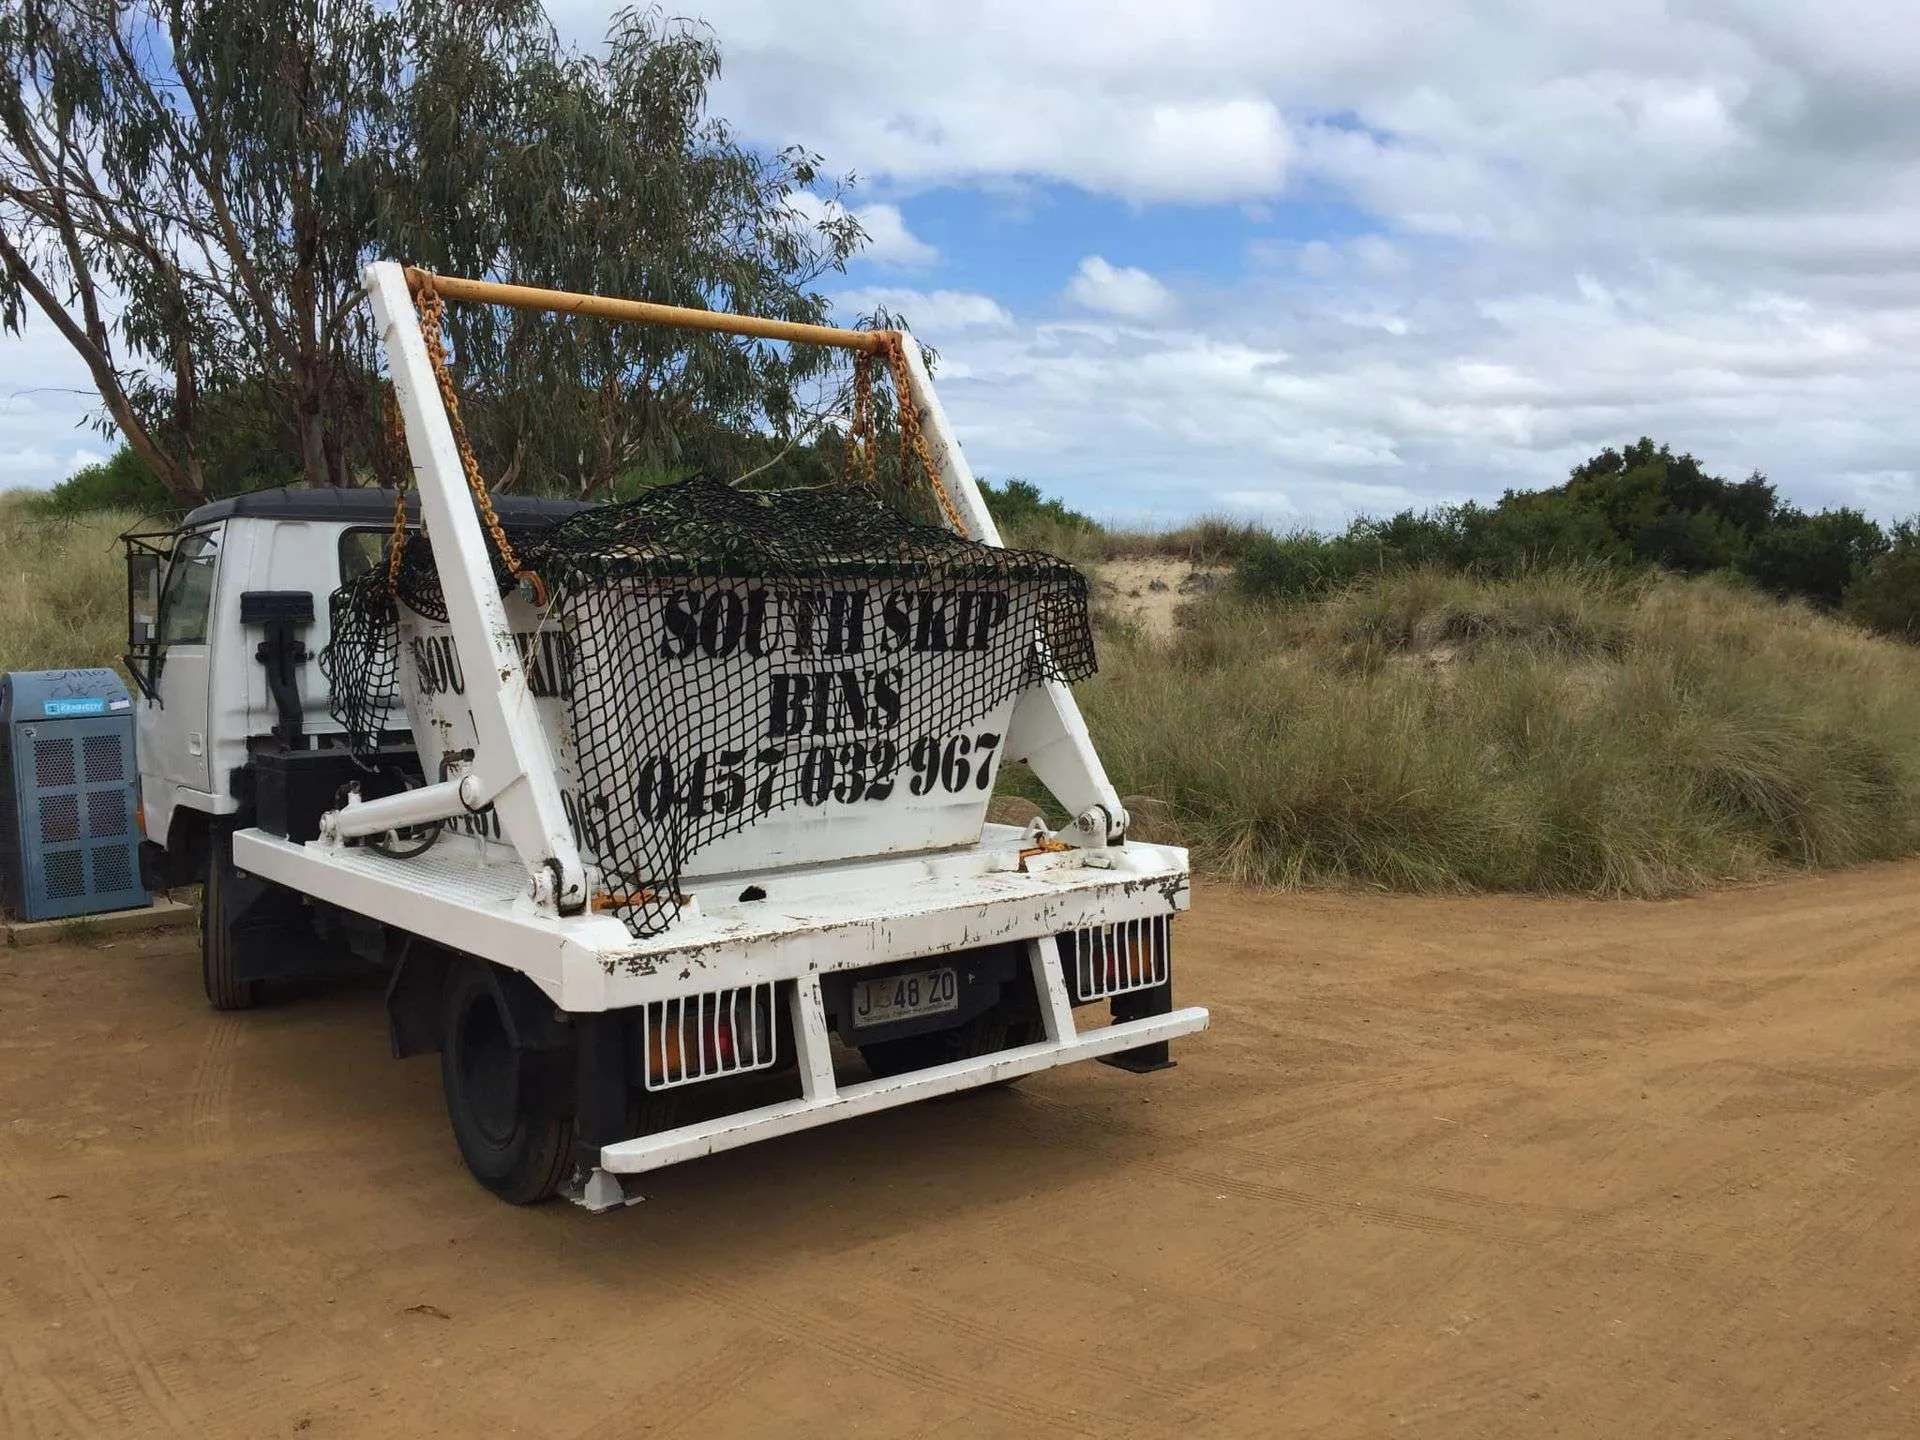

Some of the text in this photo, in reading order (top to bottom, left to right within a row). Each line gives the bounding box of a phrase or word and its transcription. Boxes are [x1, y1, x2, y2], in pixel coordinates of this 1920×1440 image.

[660, 589, 1007, 660] SOUTH SKIP
[415, 635, 465, 696] SOU
[768, 669, 902, 736] BINS
[638, 733, 1001, 822] 0457 032 967
[893, 979, 919, 1008] 48
